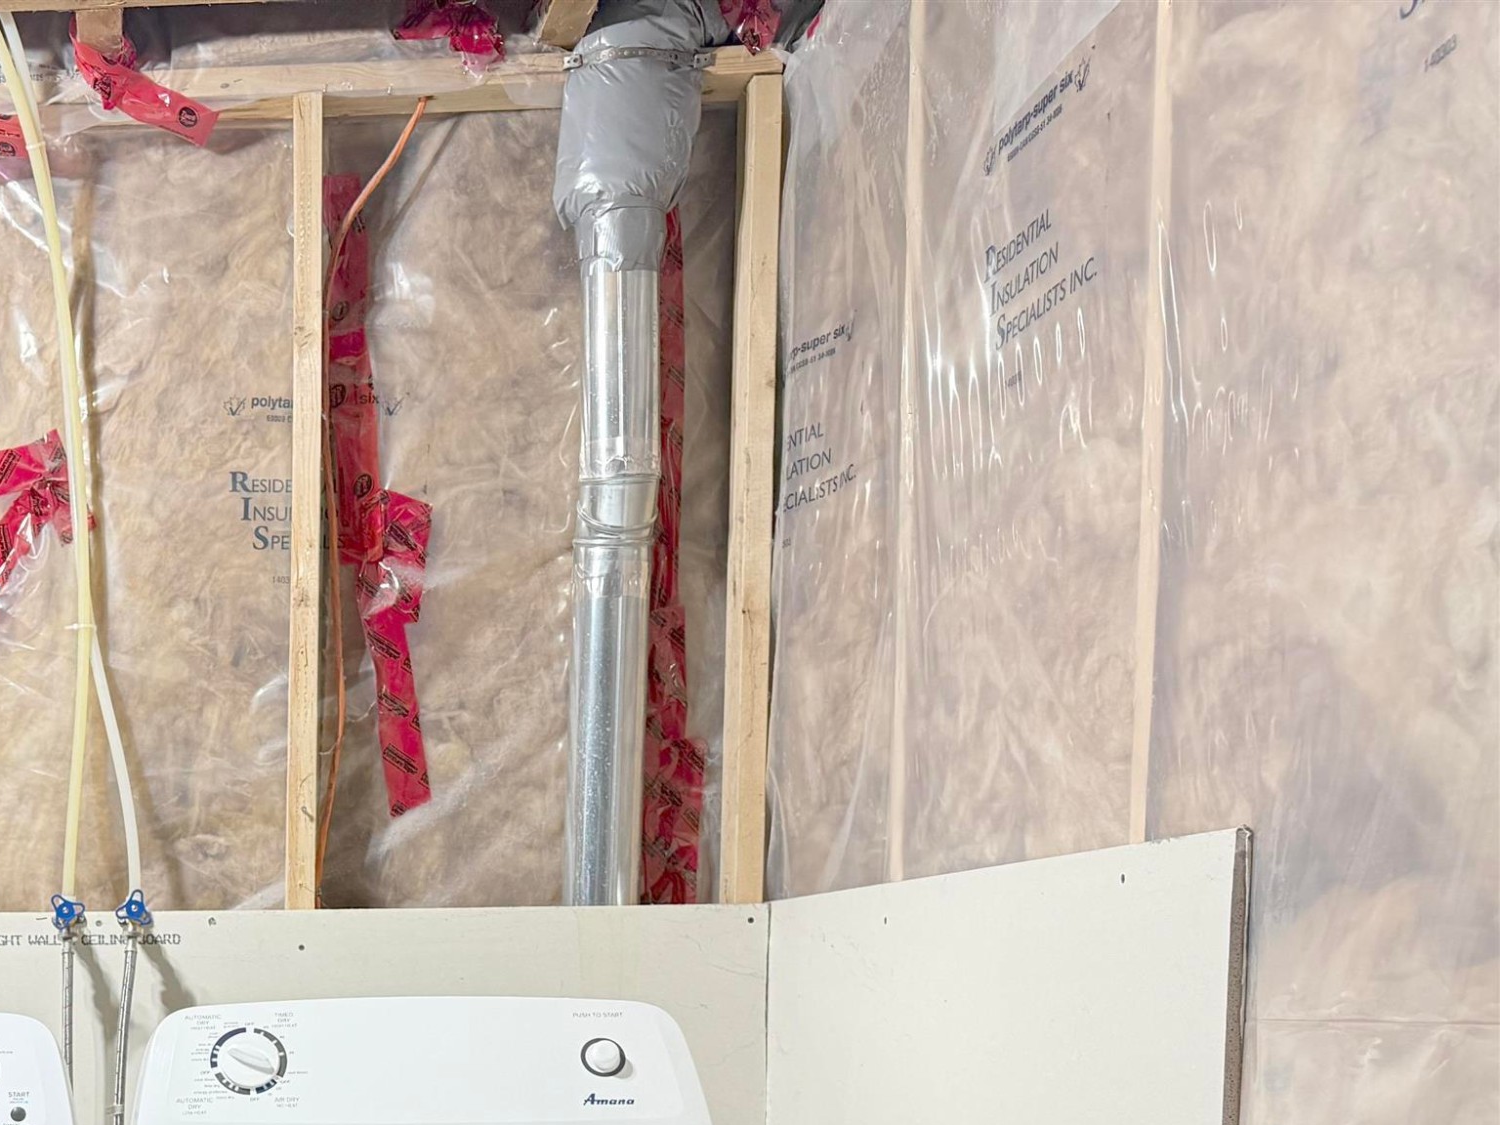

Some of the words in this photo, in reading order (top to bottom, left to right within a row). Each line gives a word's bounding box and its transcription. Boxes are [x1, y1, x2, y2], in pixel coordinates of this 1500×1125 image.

[998, 85, 1058, 155] polytarp-super
[1060, 70, 1074, 93] six
[990, 242, 1059, 317] INSULATION
[996, 278, 1066, 350] SPECIALISTS
[1069, 256, 1098, 295] INC.
[229, 471, 292, 493] RESIDE
[583, 1093, 635, 1106] Amana
